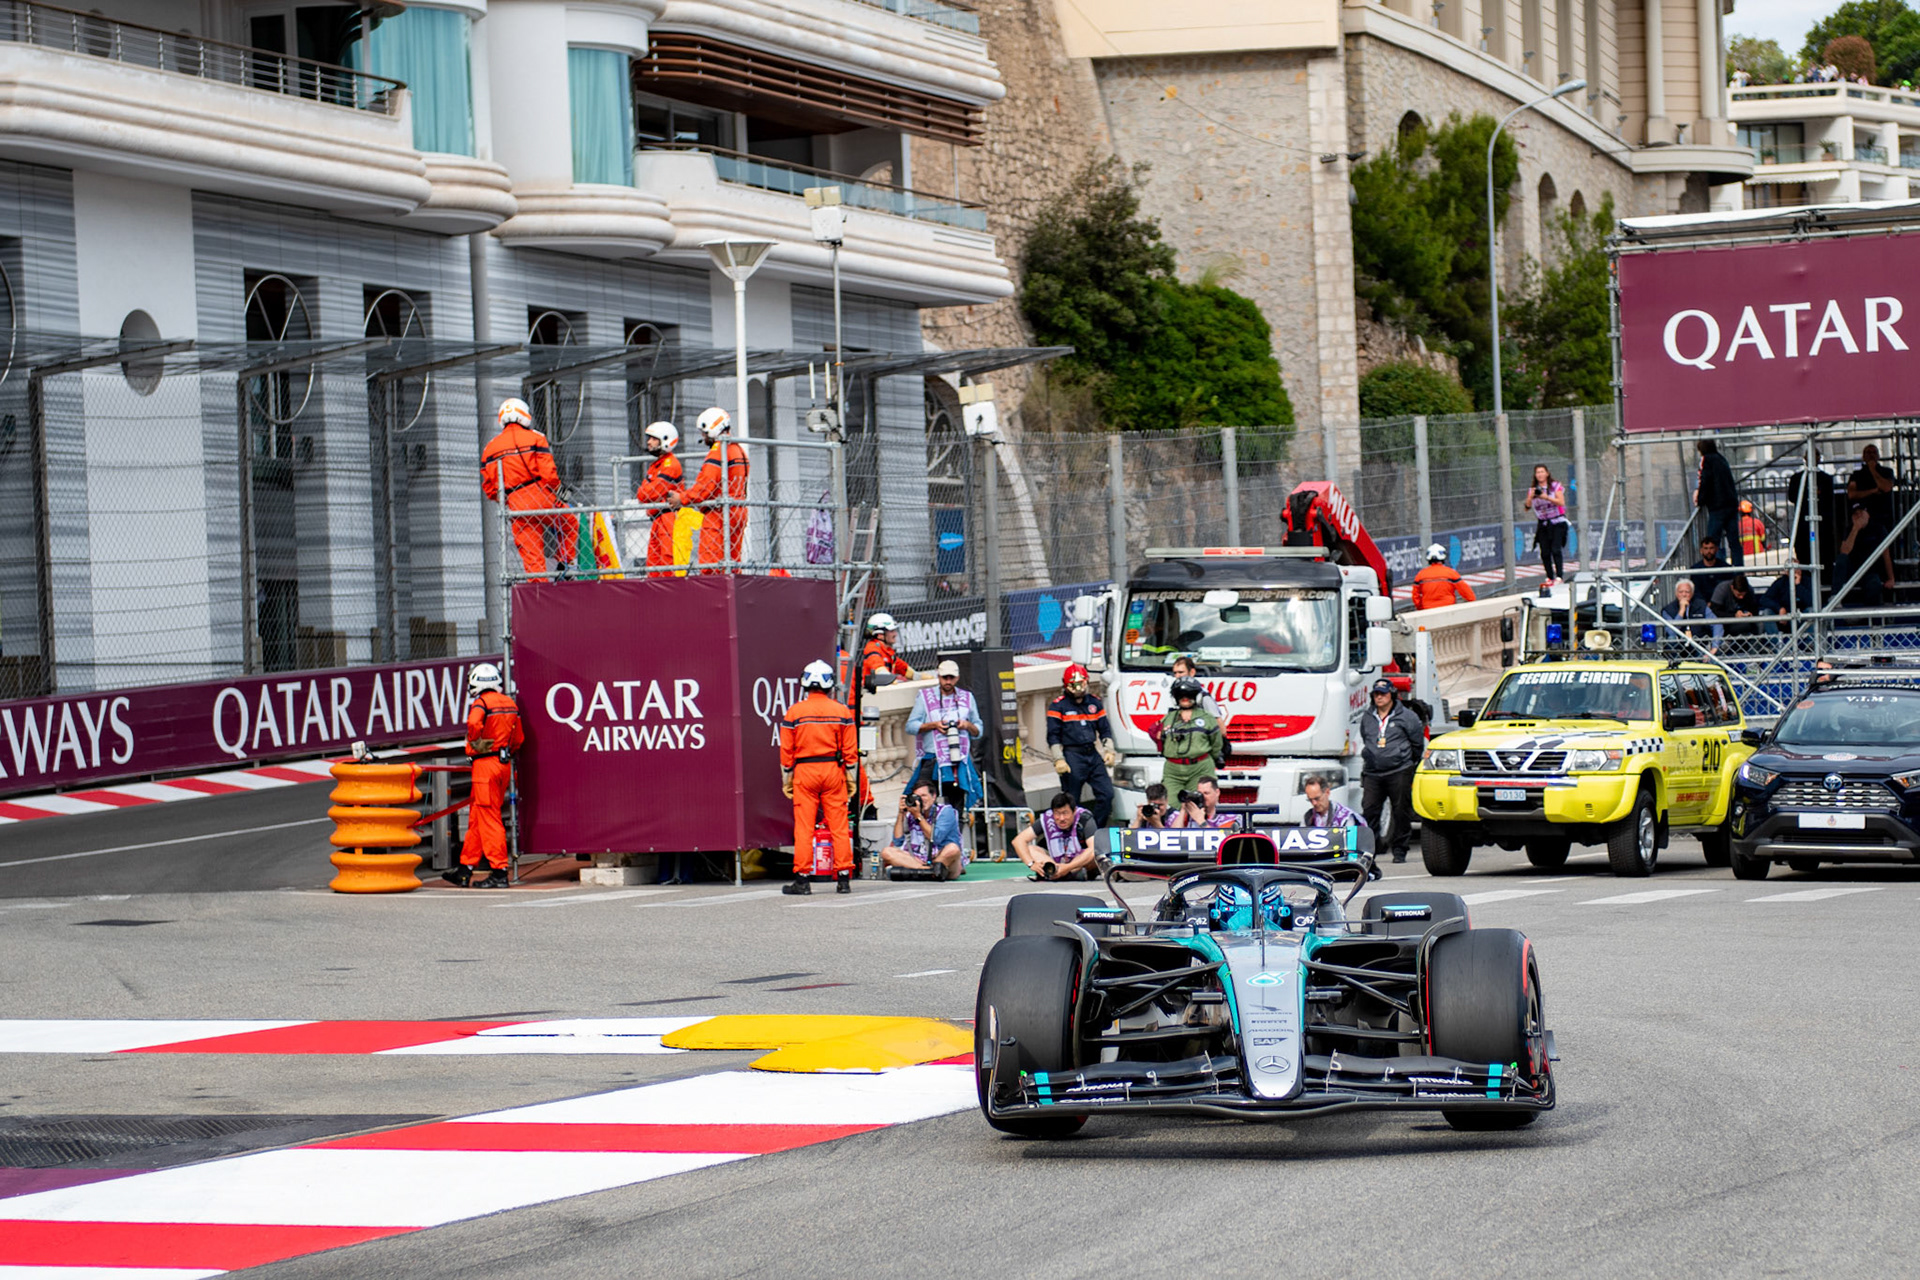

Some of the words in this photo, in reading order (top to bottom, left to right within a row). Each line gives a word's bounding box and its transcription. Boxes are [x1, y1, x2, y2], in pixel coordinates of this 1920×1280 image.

[1663, 297, 1909, 370] QATAR
[1327, 482, 1361, 543] MILLO
[1200, 681, 1257, 702] ILLO
[1517, 672, 1576, 685] SECURITE
[1579, 672, 1632, 684] CIRCUIT
[213, 677, 357, 760] QATAR
[366, 660, 516, 736] AIRW
[545, 679, 704, 732] QATAR
[1136, 691, 1162, 711] A7
[0, 696, 134, 779] WAYS
[583, 724, 706, 752] AIRWAYS
[1137, 829, 1330, 851] PETRNAS
